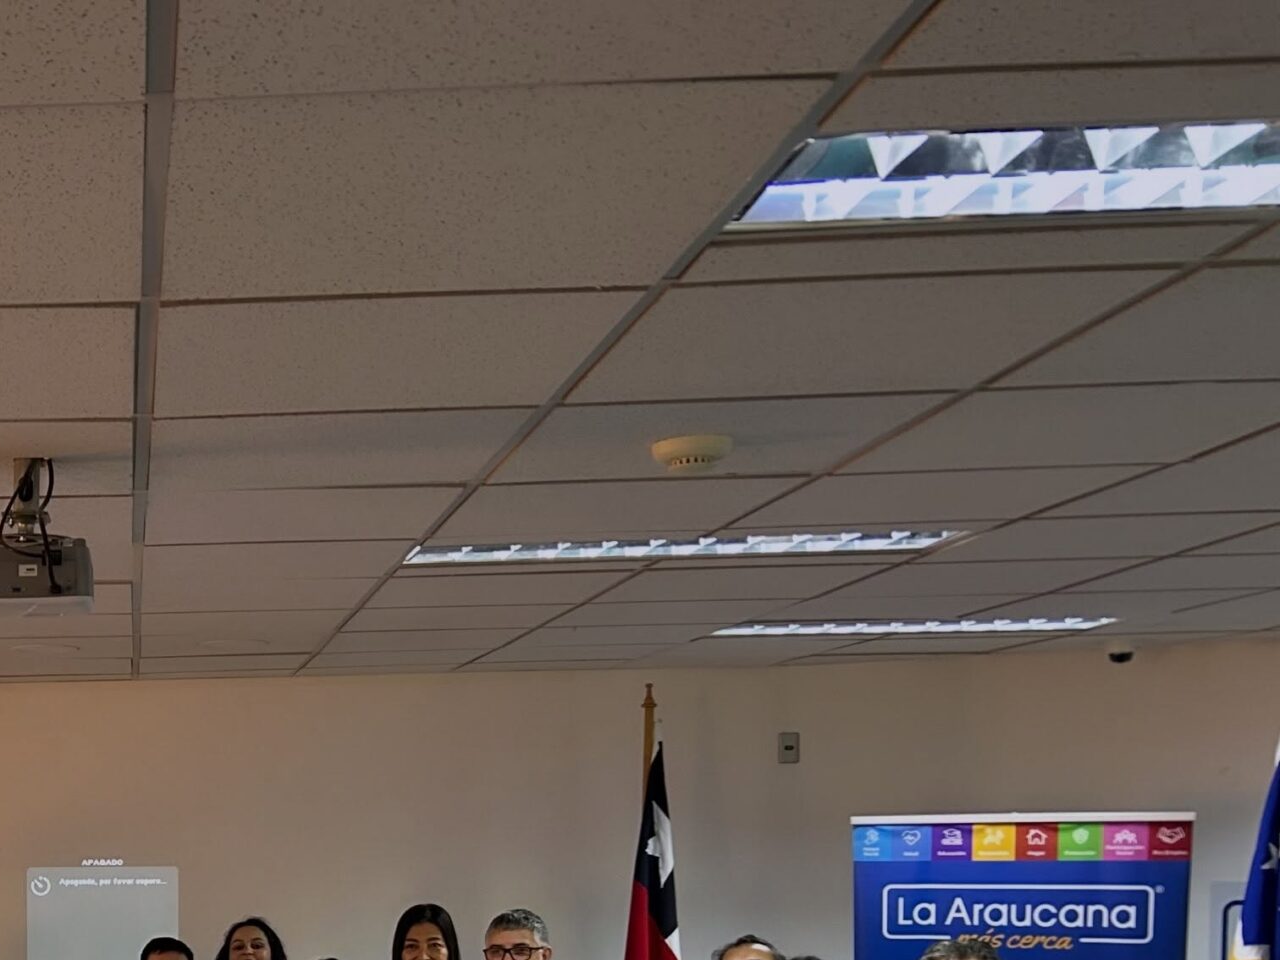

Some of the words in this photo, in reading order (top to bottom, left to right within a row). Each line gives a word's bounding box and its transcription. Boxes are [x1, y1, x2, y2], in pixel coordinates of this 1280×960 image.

[81, 859, 124, 867] APAGADO
[898, 897, 937, 926] La
[944, 897, 1138, 929] Araucana
[1006, 934, 1074, 950] cerca
